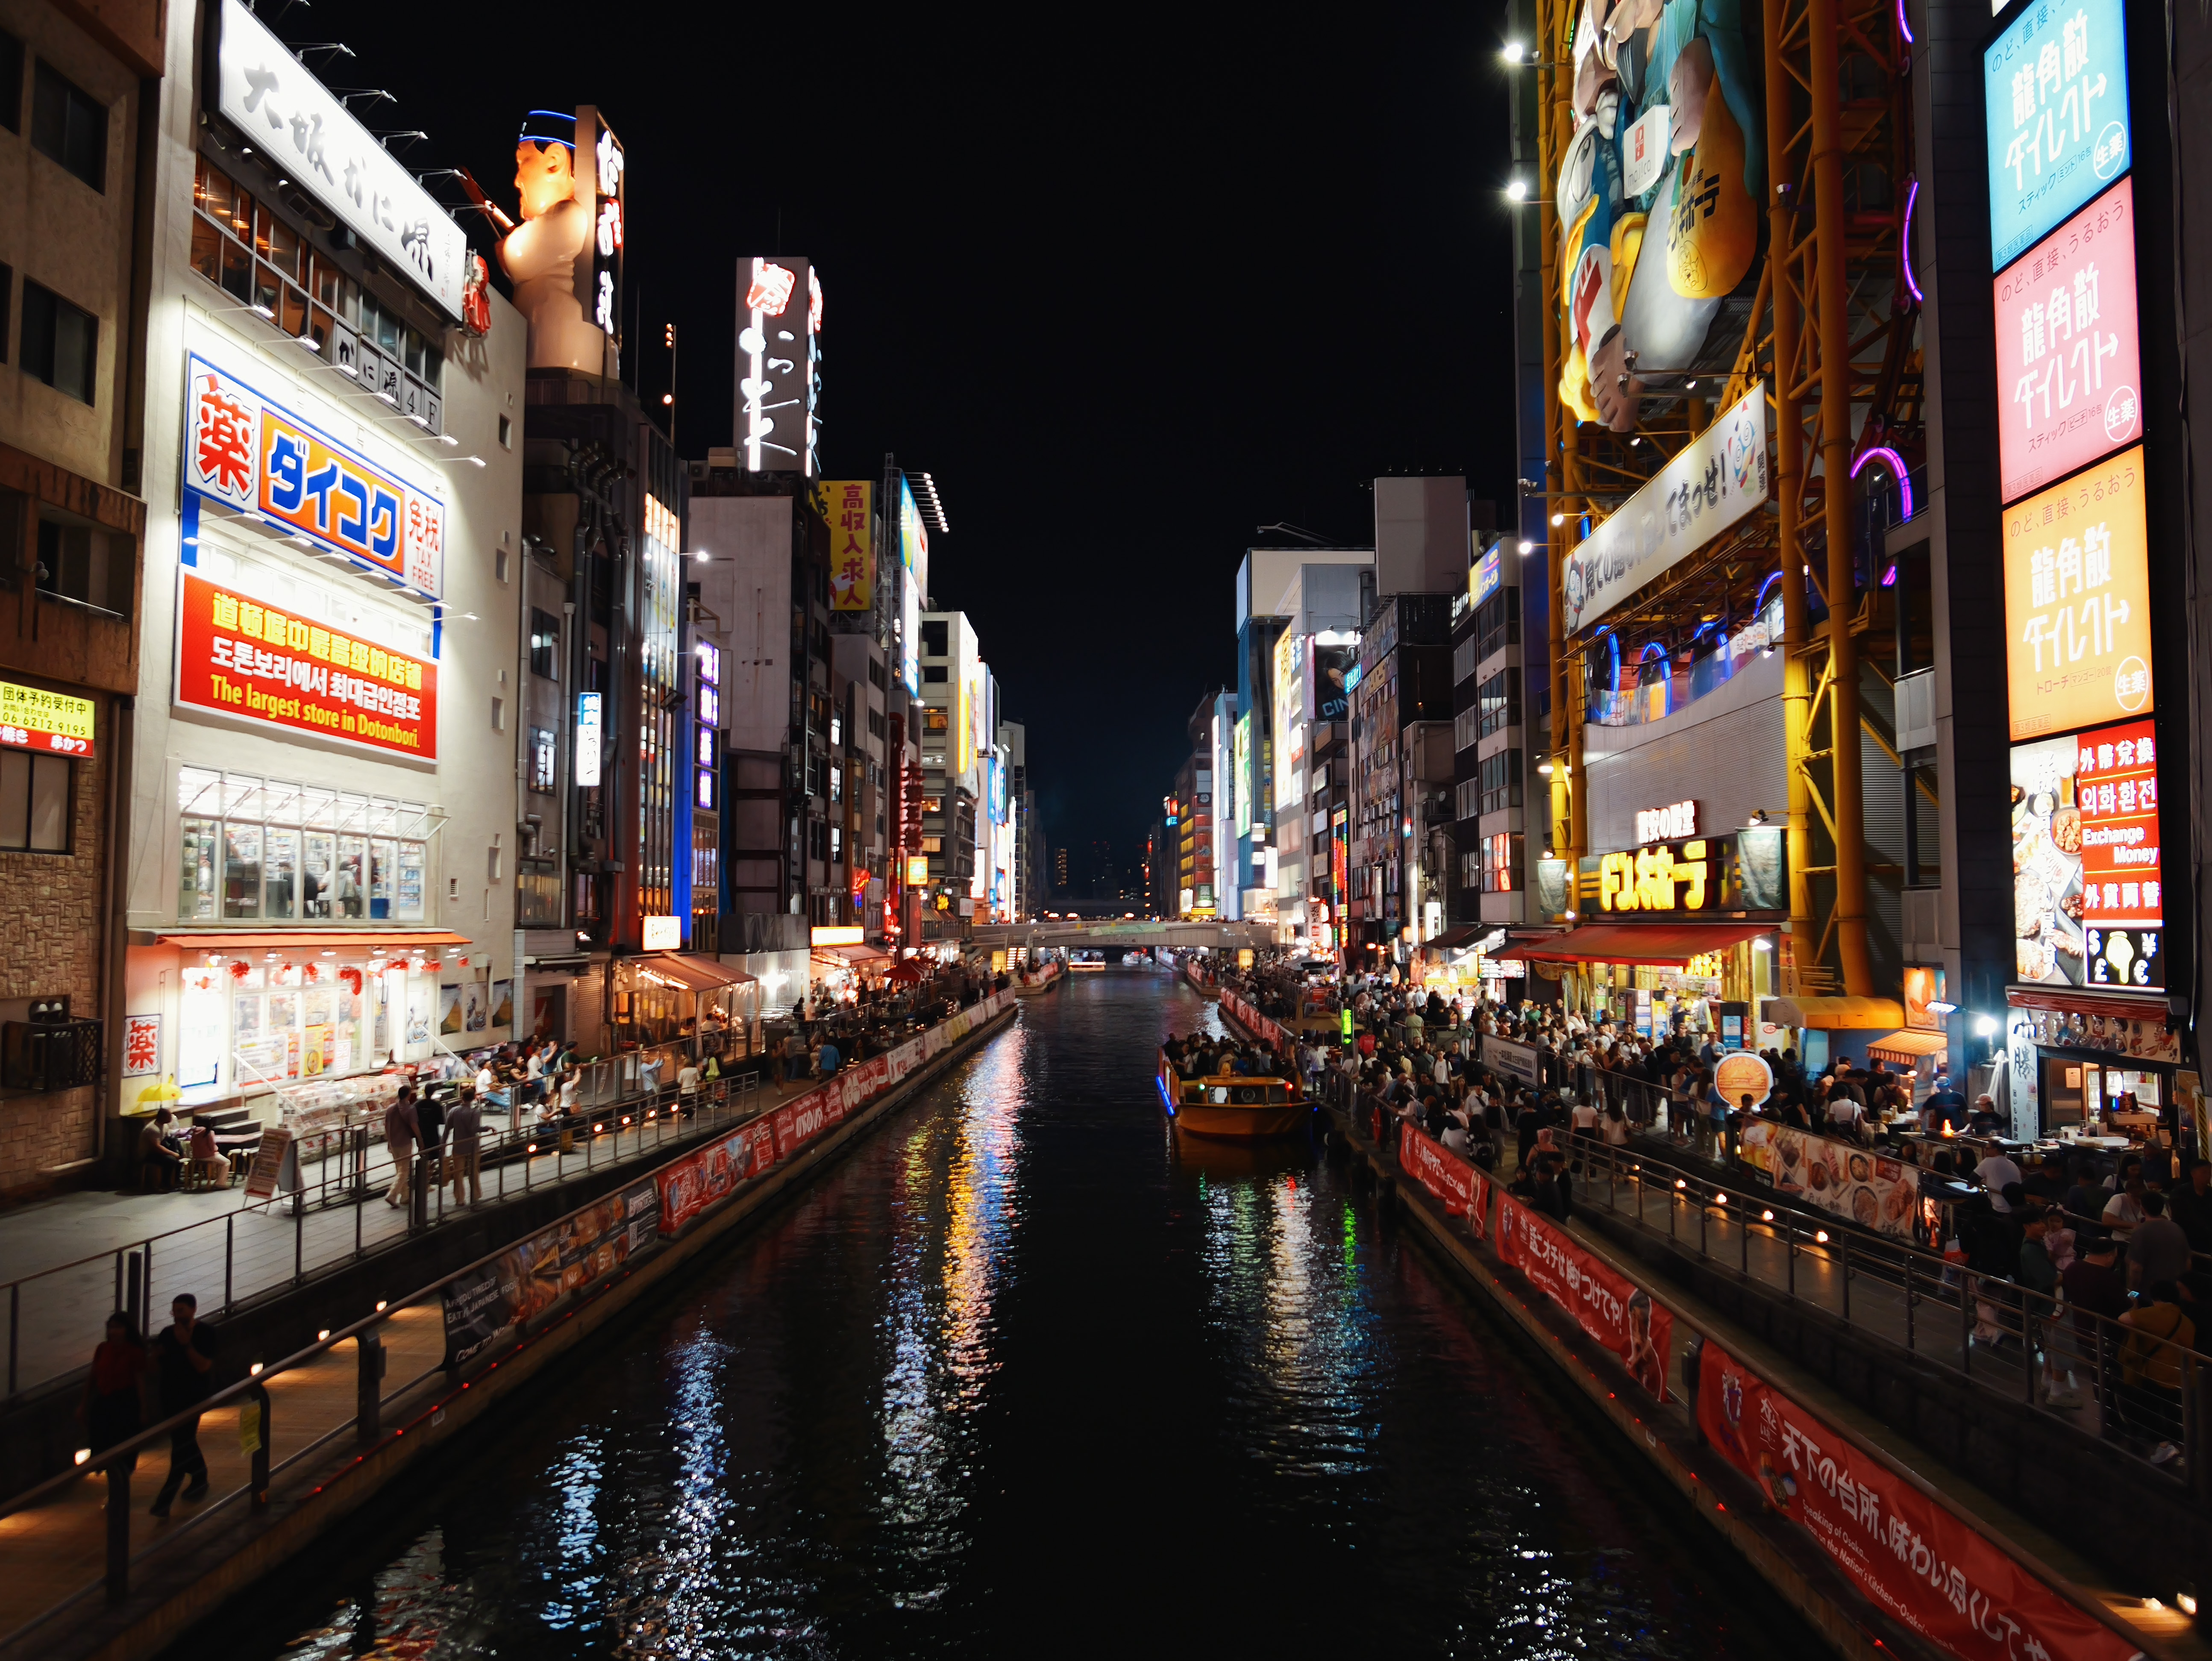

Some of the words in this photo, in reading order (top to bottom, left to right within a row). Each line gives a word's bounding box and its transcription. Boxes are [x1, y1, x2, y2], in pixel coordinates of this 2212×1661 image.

[2012, 8, 2089, 129] 龍角散
[2005, 73, 2107, 191] ダイレクト
[2095, 132, 2123, 171] 生薬
[2002, 200, 2124, 302] のど、直接、うるおう
[2021, 261, 2100, 366] 龍角散
[2014, 330, 2119, 429] ダイレクト
[2106, 397, 2135, 430] 生薬
[195, 374, 256, 500] 薬
[269, 429, 401, 562] ダイコク
[409, 497, 438, 552] 免税
[2010, 466, 2136, 538] のど、直接、うるおう
[415, 547, 433, 570] TAX
[841, 484, 866, 606] 高収入求人
[2030, 522, 2111, 608] 龍角散
[412, 570, 435, 591] FREE
[2022, 592, 2131, 672] ダイレクト
[211, 635, 327, 697] 도톤보리에서
[2118, 670, 2146, 697] 生薬
[3, 686, 86, 715] 団体予約受付中
[3, 703, 50, 718] お問い合わせは
[3, 712, 86, 735] 06-6212-9195
[210, 674, 242, 705] The
[246, 681, 300, 719] largest
[303, 703, 340, 729] store
[341, 708, 355, 732] in
[357, 713, 420, 748] Dotonbori.
[0, 725, 29, 744] 焼き
[50, 734, 87, 753] 串かつ
[2081, 777, 2157, 815] 외화환전
[2083, 826, 2144, 847] Exchange
[2113, 845, 2159, 865] Money
[2084, 880, 2160, 909] 外貨両替
[128, 1020, 159, 1070] 薬
[1827, 1537, 1839, 1555] the
[1839, 1547, 1868, 1582] Nation's
